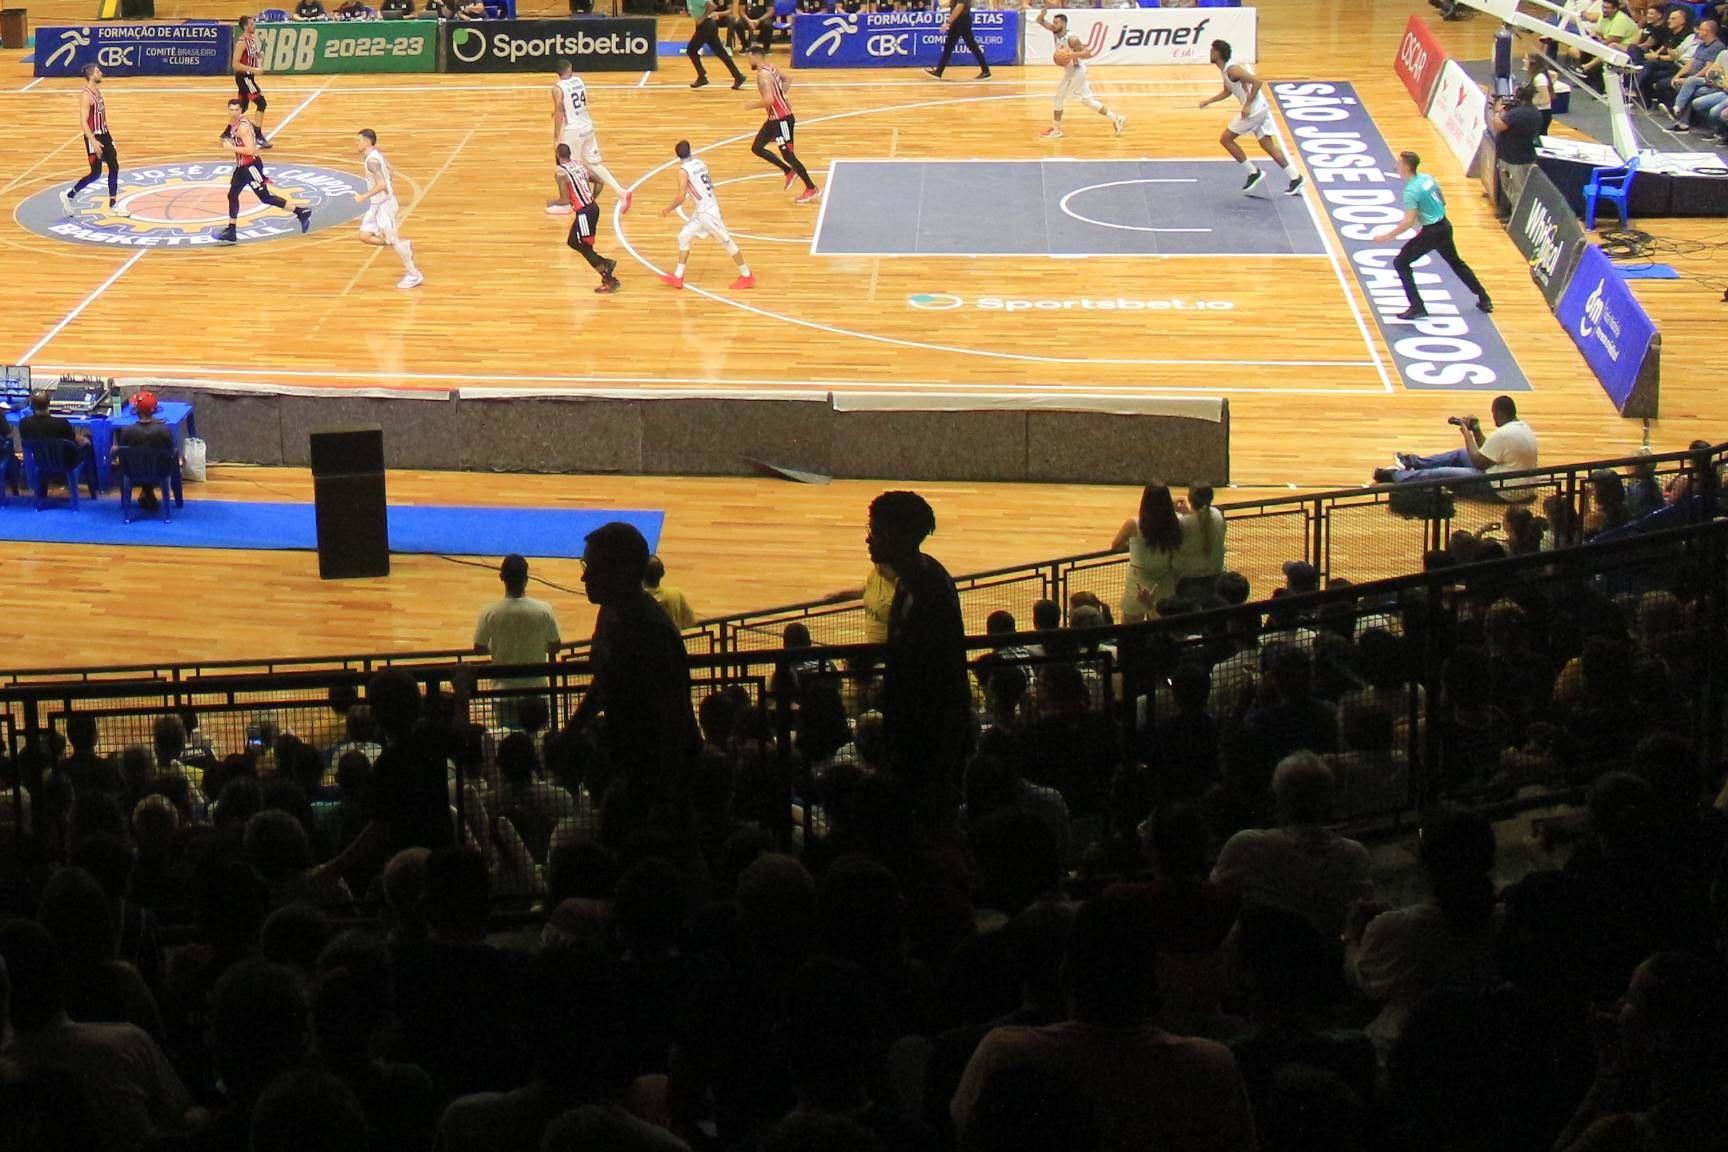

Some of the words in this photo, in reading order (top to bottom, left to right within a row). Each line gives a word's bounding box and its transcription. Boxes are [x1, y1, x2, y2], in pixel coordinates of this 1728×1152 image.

[867, 12, 932, 27] FORMAÇÃO
[98, 25, 156, 40] FORMAÇÃO
[158, 27, 172, 38] DE
[173, 27, 218, 38] ATLETAS
[1110, 18, 1210, 51] jamef
[97, 46, 134, 67] CBC
[146, 46, 175, 56] COMITÊ
[177, 48, 217, 57] BRASILEIRO
[324, 36, 426, 58] 2022-23
[492, 31, 649, 63] Sportsbet.io
[866, 33, 909, 57] CBC
[169, 56, 200, 65] CLUBES
[1401, 31, 1427, 83] OSCAR
[571, 90, 587, 110] 24
[1274, 83, 1357, 122] SÃO
[1294, 126, 1401, 183] JOSÉ
[132, 164, 203, 181] JOSÉ
[278, 169, 360, 196] CAMPOS
[1323, 189, 1416, 241] DOS
[975, 297, 1235, 312] Sportsbet.io
